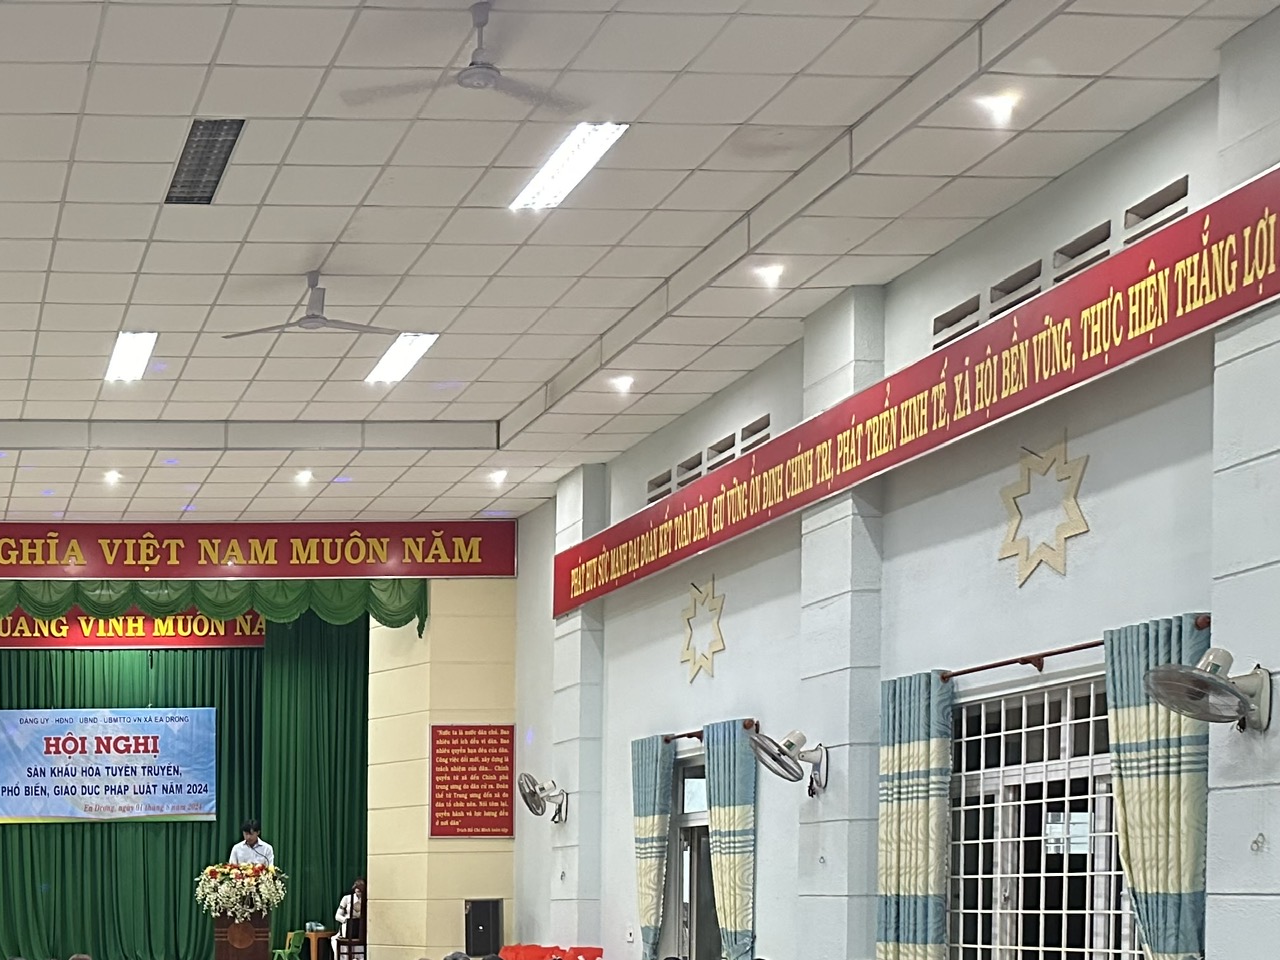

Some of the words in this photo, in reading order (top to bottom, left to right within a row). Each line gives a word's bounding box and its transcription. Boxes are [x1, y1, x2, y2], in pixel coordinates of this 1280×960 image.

[749, 454, 762, 516] ỔN
[762, 463, 784, 517] ĐỊNH
[785, 441, 814, 500] CHÍNH
[816, 438, 834, 491] TRỊ,
[836, 414, 863, 476] PHÁT
[865, 382, 898, 462] TRIỂN
[899, 389, 929, 446] KINH
[931, 356, 950, 431] TẾ,
[953, 356, 971, 421] XÃ
[974, 344, 998, 418] HỘI
[1001, 315, 1029, 399] BỀN
[1032, 315, 1076, 383] VỮNG,
[1080, 286, 1124, 365] THỰC
[1127, 258, 1170, 344] HIỆN
[1174, 214, 1238, 318] THẮNG
[1242, 206, 1277, 295] LỢI
[97, 531, 184, 572] VIỆT
[198, 538, 277, 567] NAM
[290, 529, 390, 565] MUÔN
[401, 529, 483, 564] NĂM
[78, 615, 145, 637] VINH
[44, 732, 87, 759] HỘI
[95, 735, 159, 758] NGHỊ
[26, 764, 46, 777] SÂN
[50, 764, 77, 777] KHẤU
[162, 782, 183, 794] NĂM
[186, 783, 209, 795] 2024
